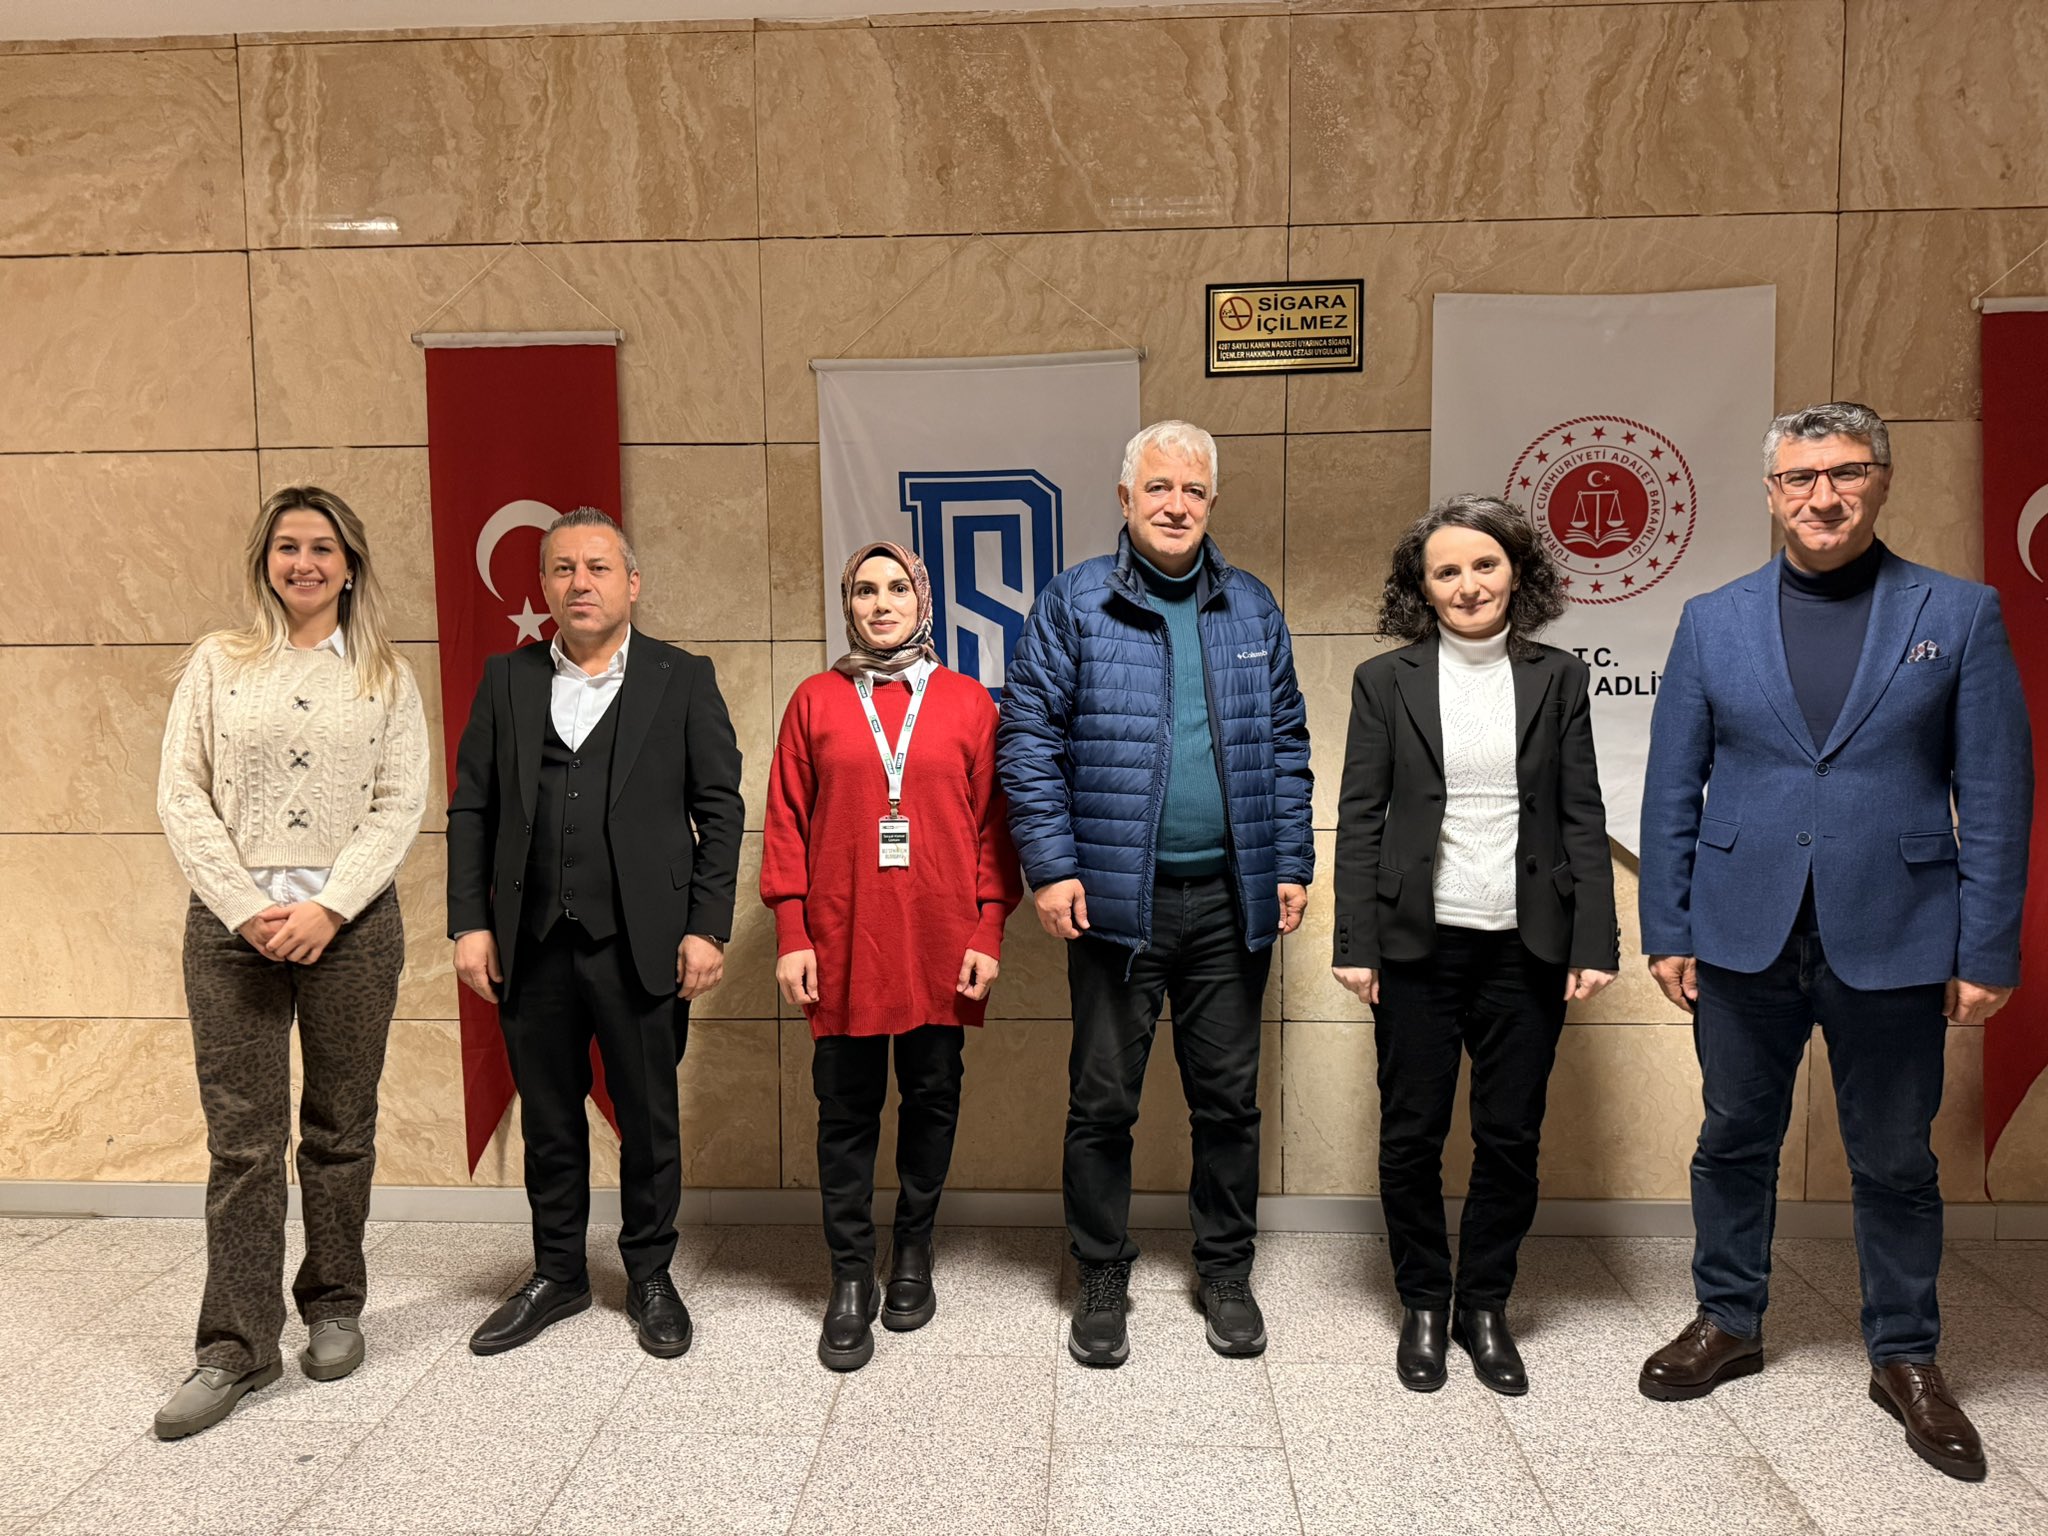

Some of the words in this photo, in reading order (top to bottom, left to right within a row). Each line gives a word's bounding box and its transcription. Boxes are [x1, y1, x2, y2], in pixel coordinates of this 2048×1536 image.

[1258, 293, 1347, 311] SİGARA
[1257, 313, 1348, 335] İÇİLMEZ
[1220, 351, 1245, 360] İÇENLER
[1245, 350, 1275, 358] HAKKINDA
[1276, 349, 1292, 357] PARA
[1292, 348, 1313, 356] CEZASI
[1314, 347, 1348, 356] UYGULANIR
[1250, 341, 1271, 349] KANUN
[1271, 339, 1297, 349] MADDESİ
[1298, 339, 1327, 347] UYARINCA
[1328, 338, 1350, 346] SİGARA
[1536, 449, 1606, 510] CUMHURİYETİ
[1611, 452, 1654, 486] ADALET
[1627, 489, 1660, 558] BAKANLIĞI
[1242, 649, 1268, 659] Columb
[1572, 647, 1619, 667] T.C.
[1594, 670, 1662, 696] ADLİ
